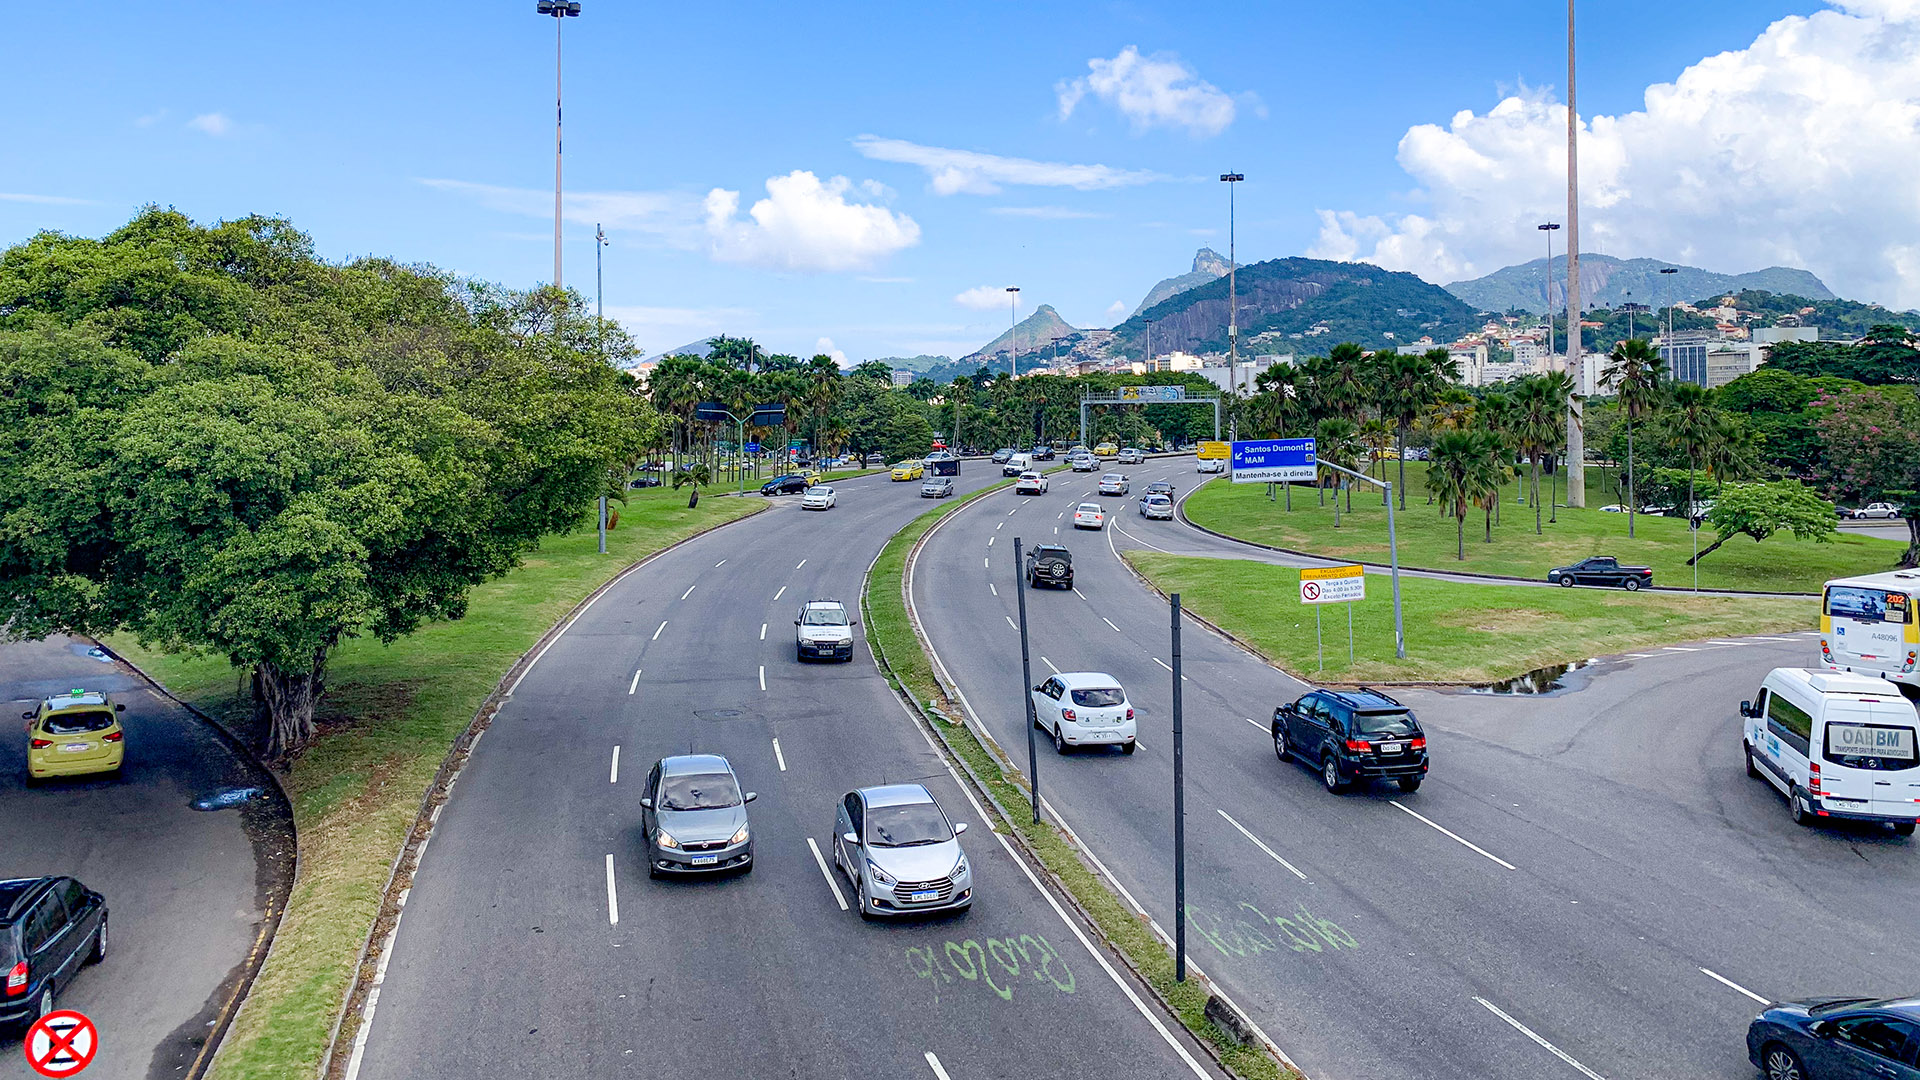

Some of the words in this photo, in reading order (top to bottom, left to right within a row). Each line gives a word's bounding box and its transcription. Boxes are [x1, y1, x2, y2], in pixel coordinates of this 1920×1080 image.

[1245, 445, 1271, 453] Santos
[1272, 444, 1304, 452] Dumont
[1236, 471, 1281, 479] Mantenha-se
[1887, 594, 1905, 604] 202
[1871, 633, 1898, 642] A48096
[1876, 731, 1900, 747] BM
[1834, 745, 1858, 754] TRANSPORTE
[1887, 748, 1909, 757] ADVOGADOS
